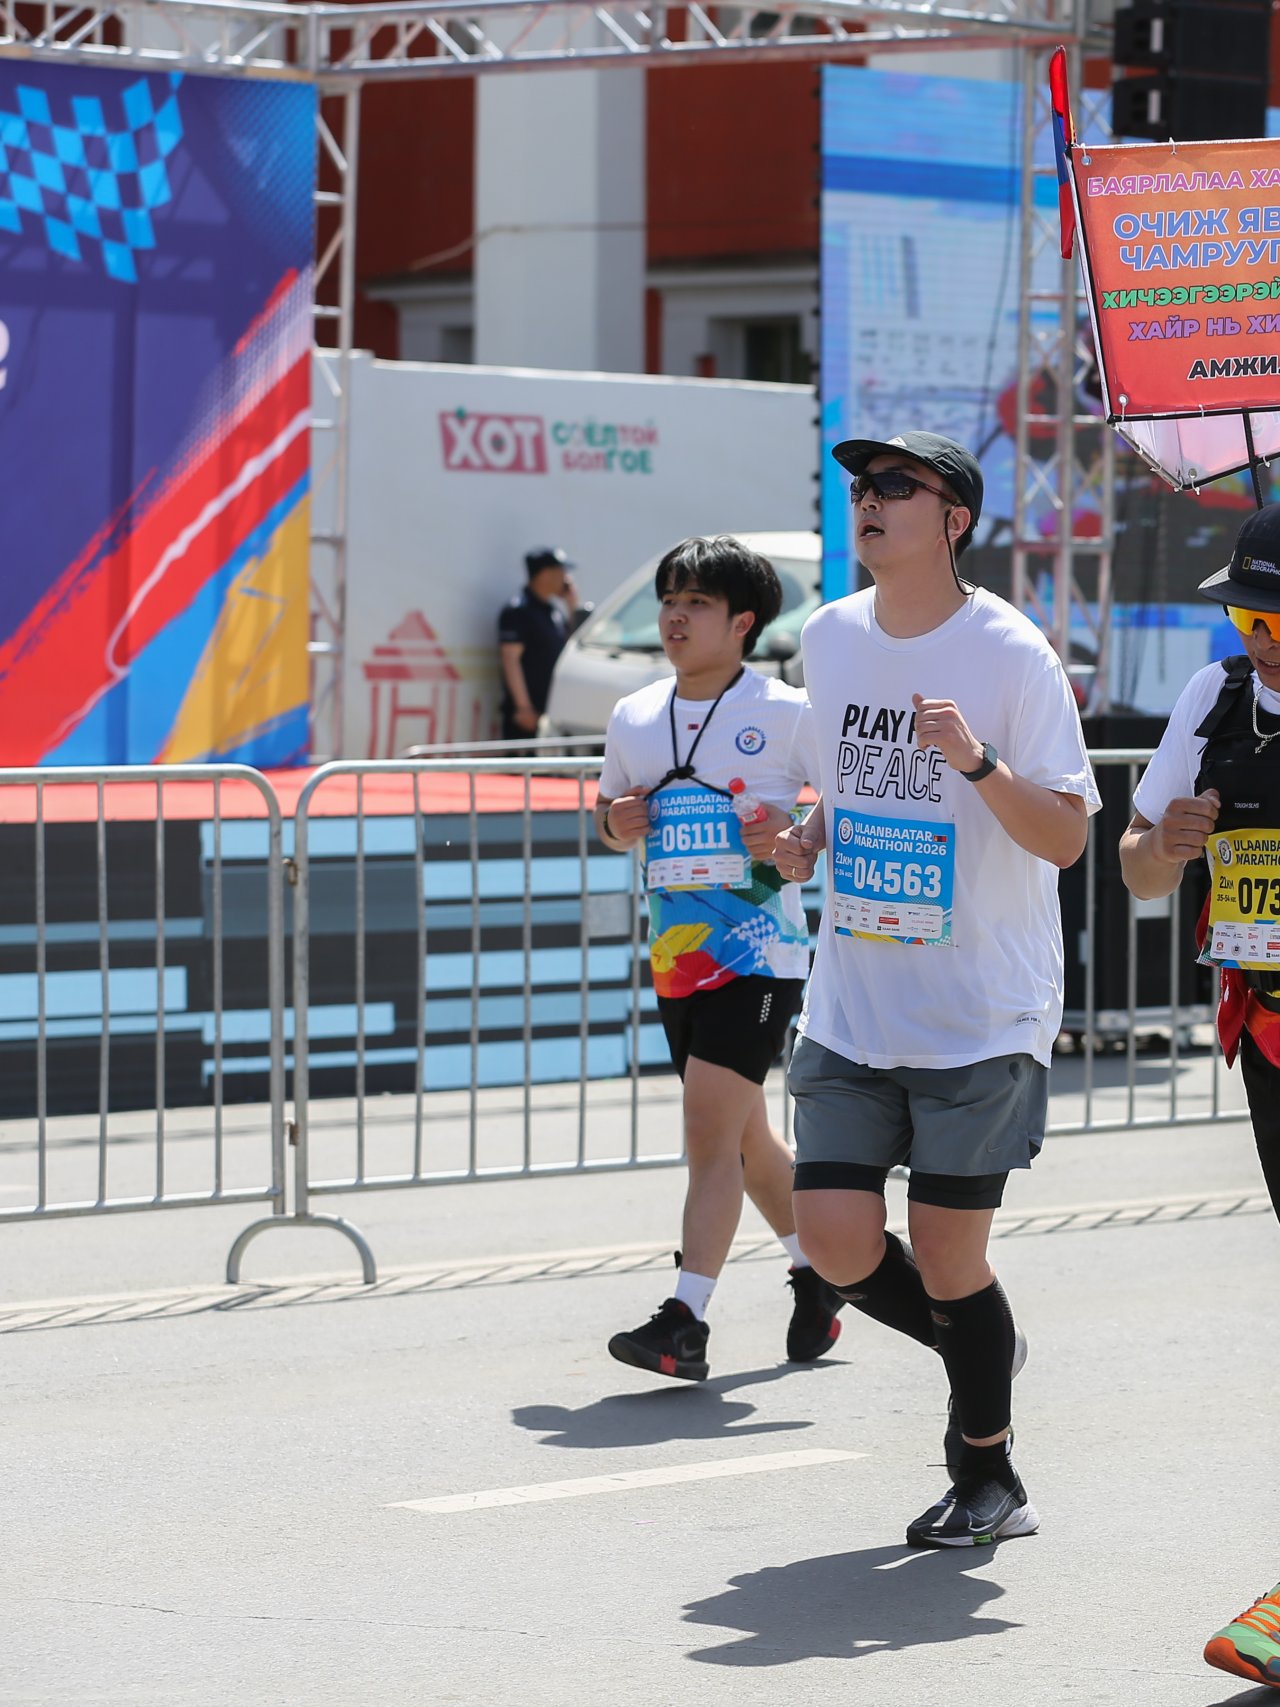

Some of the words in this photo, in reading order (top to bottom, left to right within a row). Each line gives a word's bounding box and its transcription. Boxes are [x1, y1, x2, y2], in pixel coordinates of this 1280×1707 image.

[1087, 170, 1244, 197] БАЯРЛАЛАА
[1113, 207, 1229, 241] ОЧИЖ
[1128, 315, 1200, 341] ХАЙР
[1206, 316, 1241, 337] НЬ
[447, 415, 540, 469] ХОТ
[1251, 559, 1276, 569] NATIONAL
[841, 704, 906, 743] PLAY
[837, 741, 947, 803] PEACE
[661, 805, 715, 817] MARATHON
[662, 821, 730, 852] 06111
[854, 821, 933, 843] ULAANBAATAR
[854, 834, 914, 853] MARATHON
[915, 842, 947, 856] 2026
[835, 851, 853, 867] 21KM
[853, 856, 943, 898] 04563
